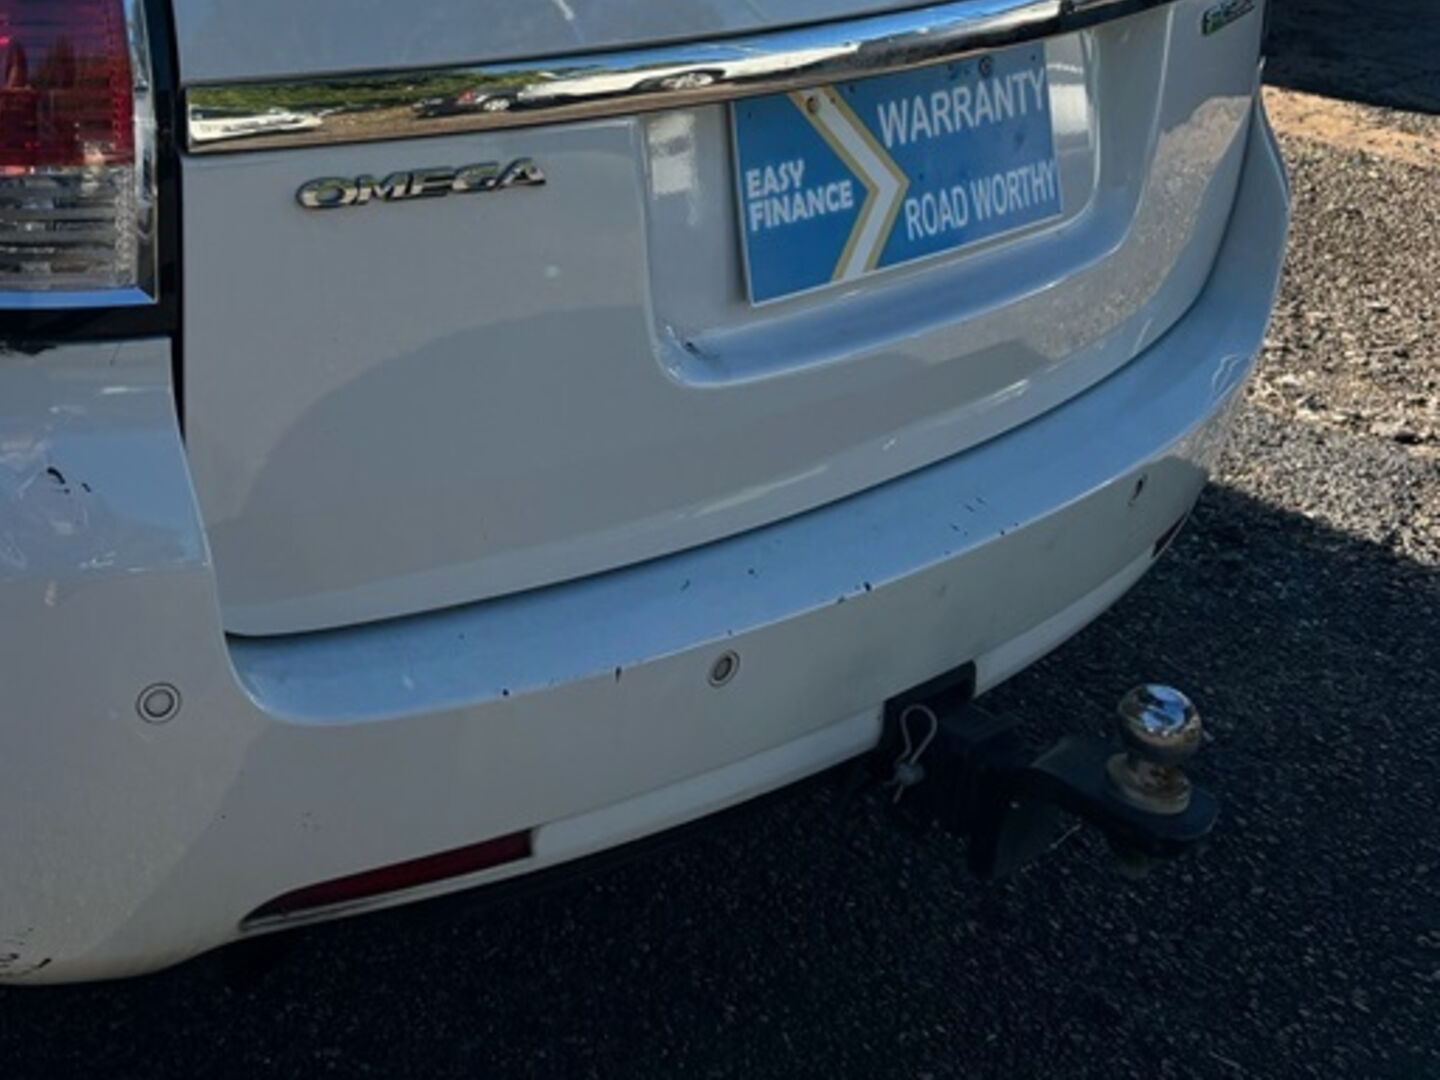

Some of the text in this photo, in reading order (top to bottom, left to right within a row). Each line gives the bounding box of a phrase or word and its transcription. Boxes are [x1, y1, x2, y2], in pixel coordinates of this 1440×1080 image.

[876, 67, 1046, 149] WARRANTY
[295, 157, 546, 209] OMEGA
[745, 159, 805, 199] EASY
[904, 160, 1057, 241] ROAD WORTHY
[749, 180, 854, 232] FINANCE
